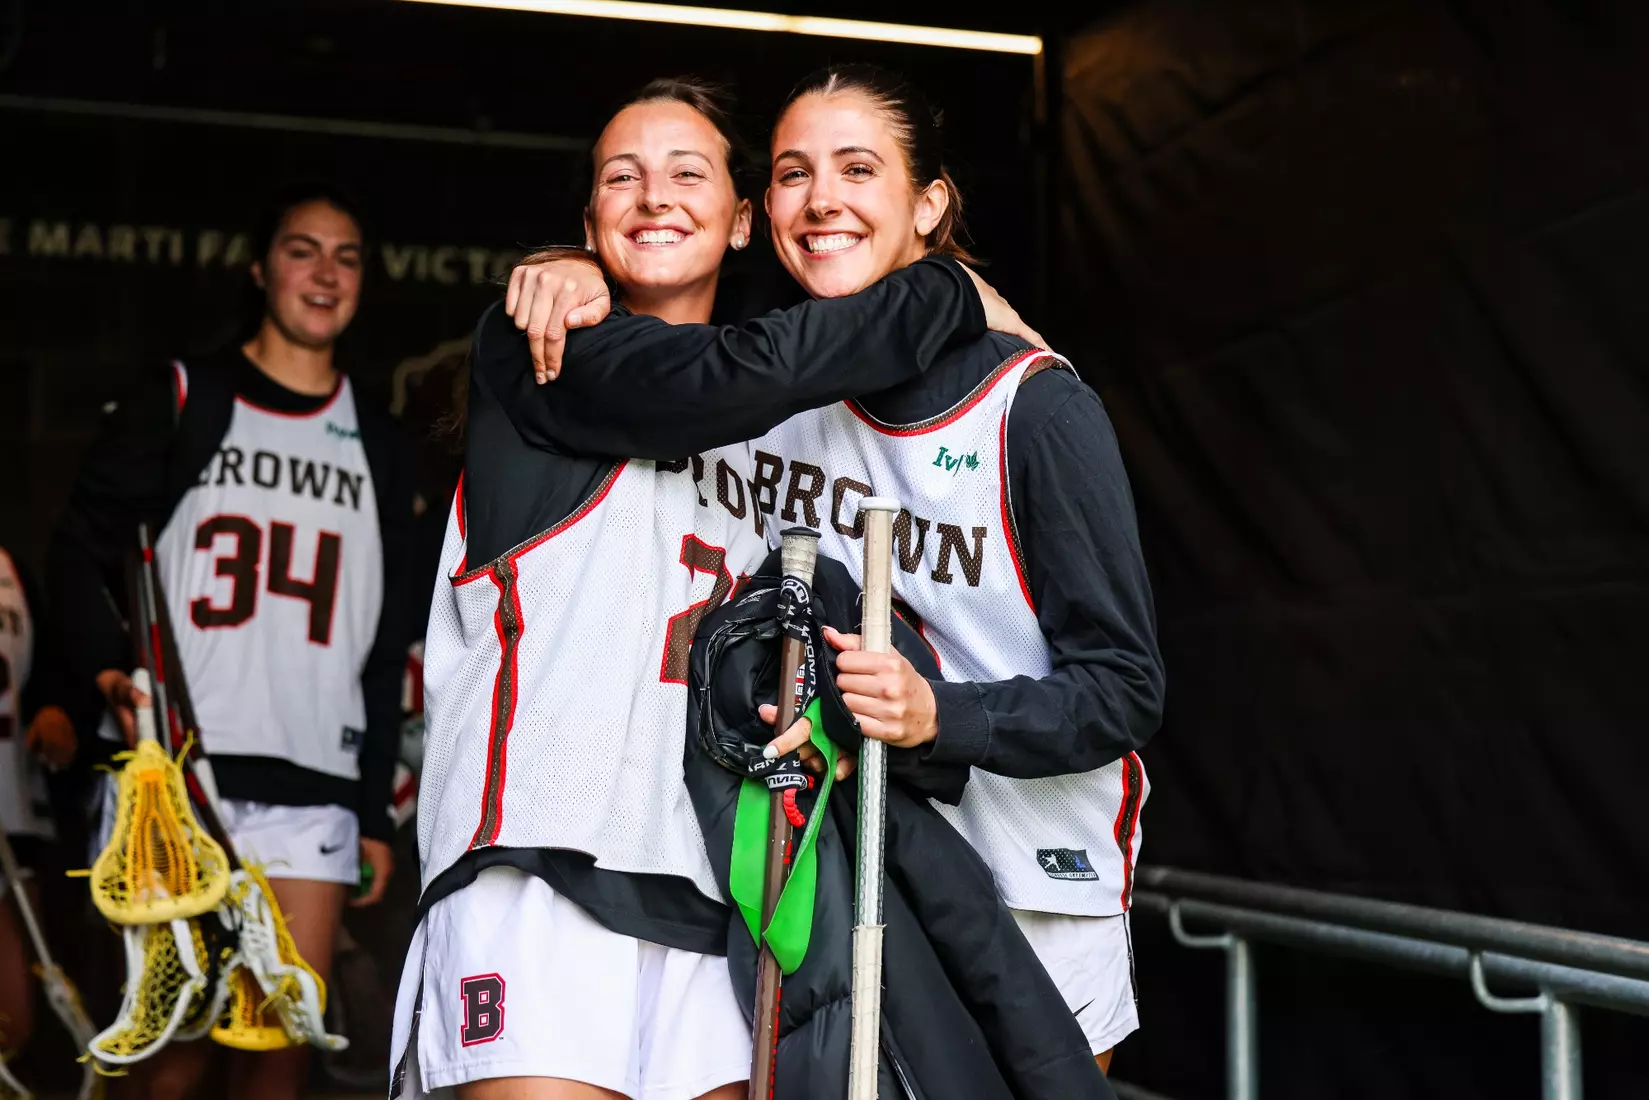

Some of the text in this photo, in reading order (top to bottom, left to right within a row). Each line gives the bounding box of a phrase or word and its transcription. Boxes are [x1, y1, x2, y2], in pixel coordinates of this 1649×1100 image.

[28, 218, 184, 268] MARTI
[199, 447, 363, 511] ROWN
[190, 513, 341, 645] 34
[660, 533, 751, 687] 2
[461, 972, 506, 1048] B
